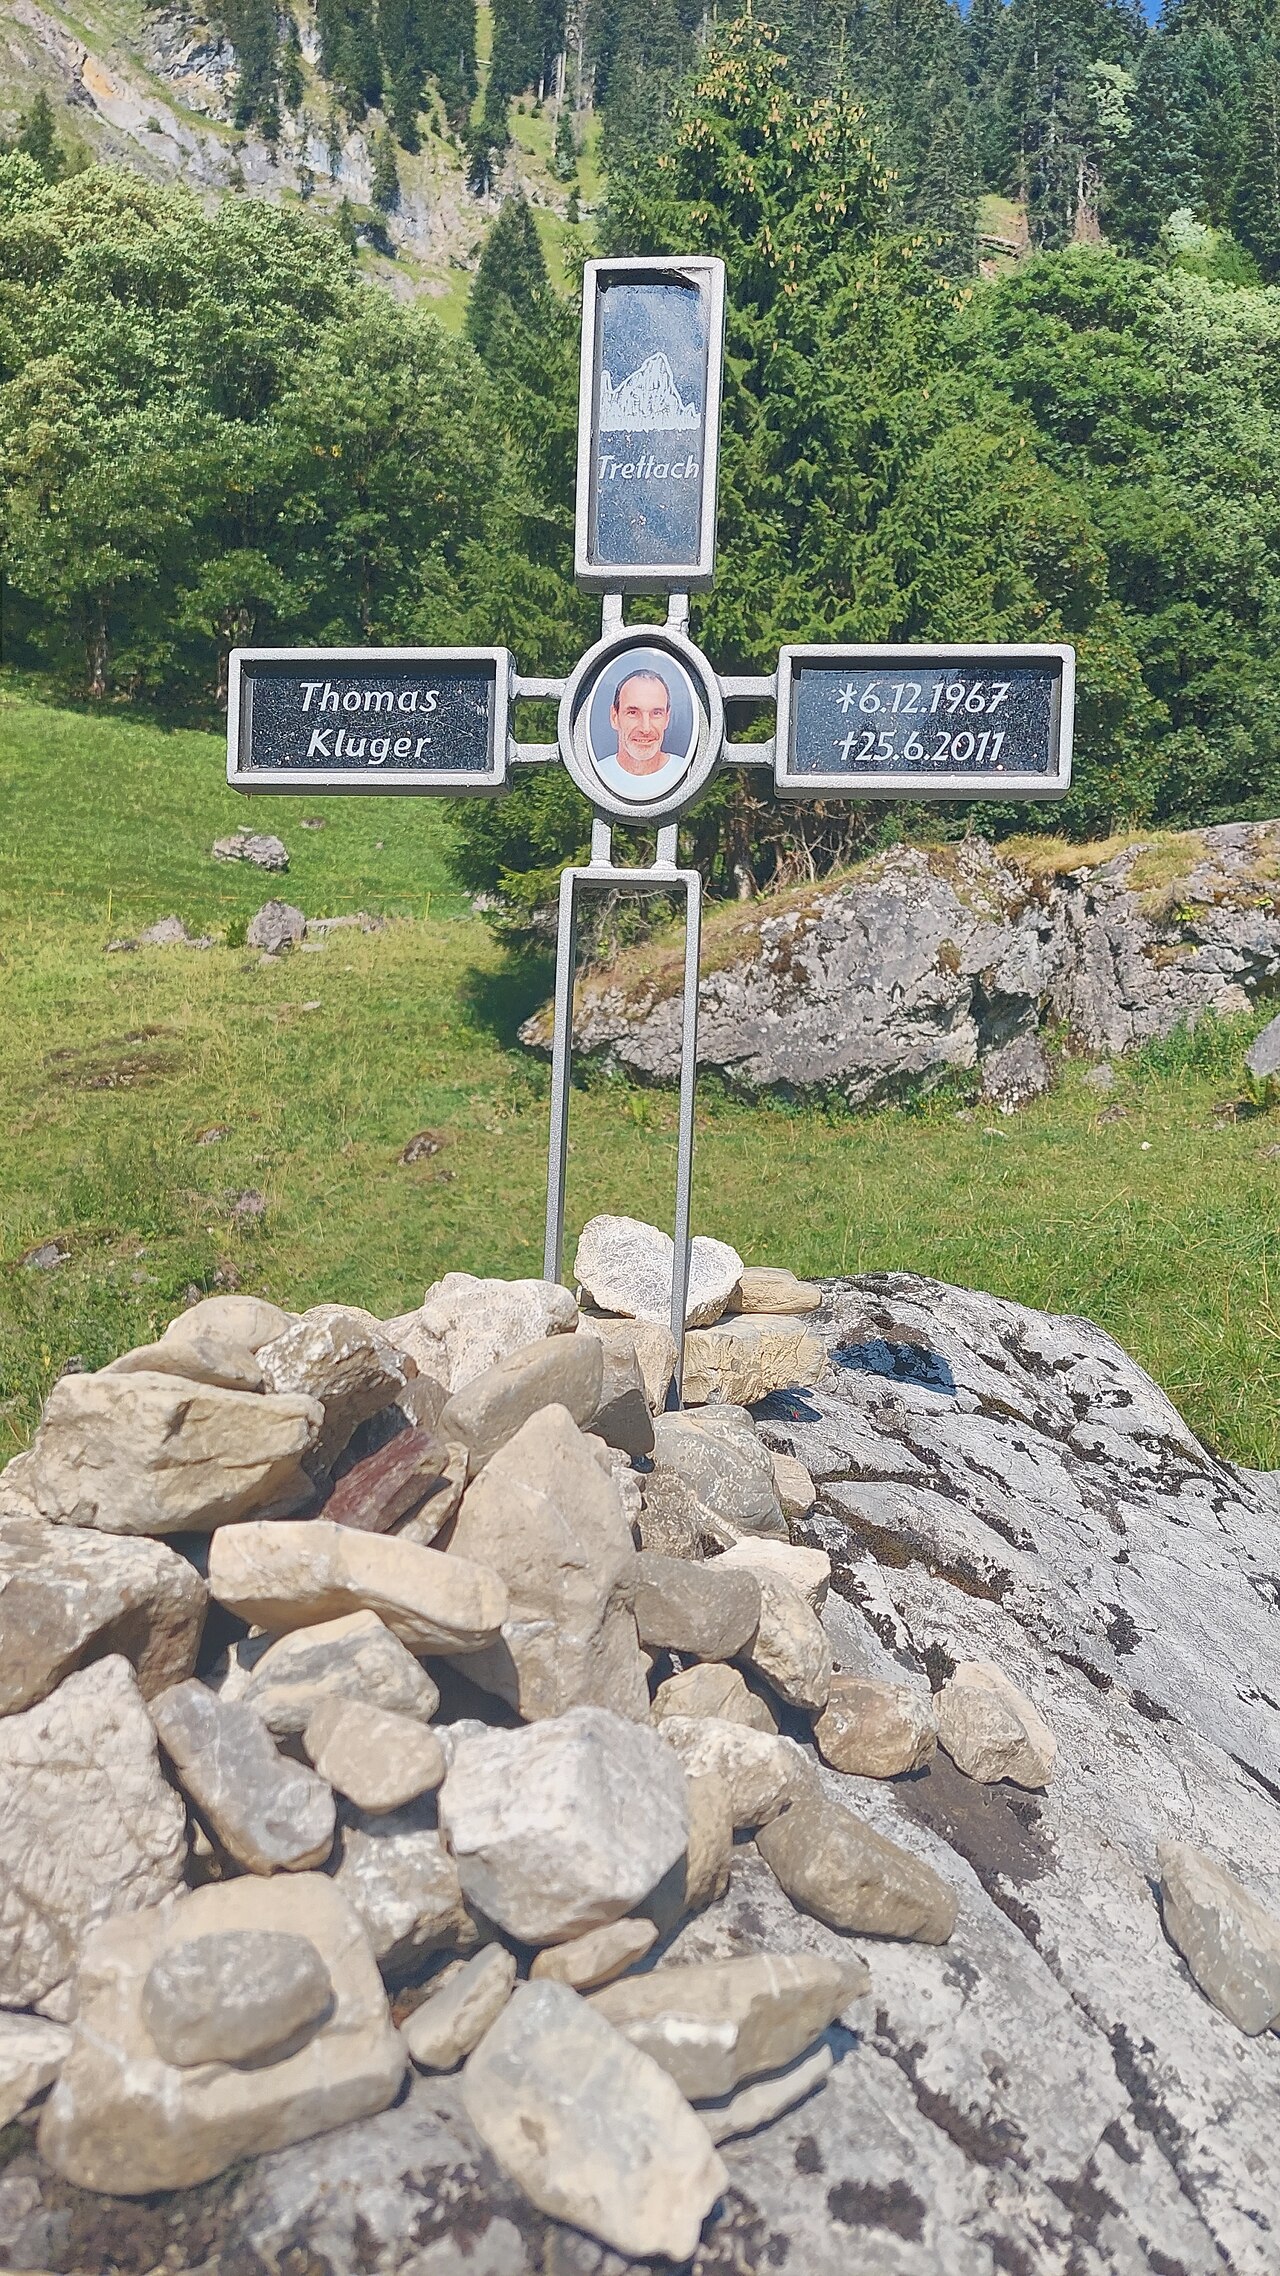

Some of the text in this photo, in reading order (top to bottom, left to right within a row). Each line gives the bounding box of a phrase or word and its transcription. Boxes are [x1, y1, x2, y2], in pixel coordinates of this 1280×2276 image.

[598, 455, 700, 480] Trettach
[299, 682, 440, 712] Thomas
[306, 728, 432, 765] Kluger
